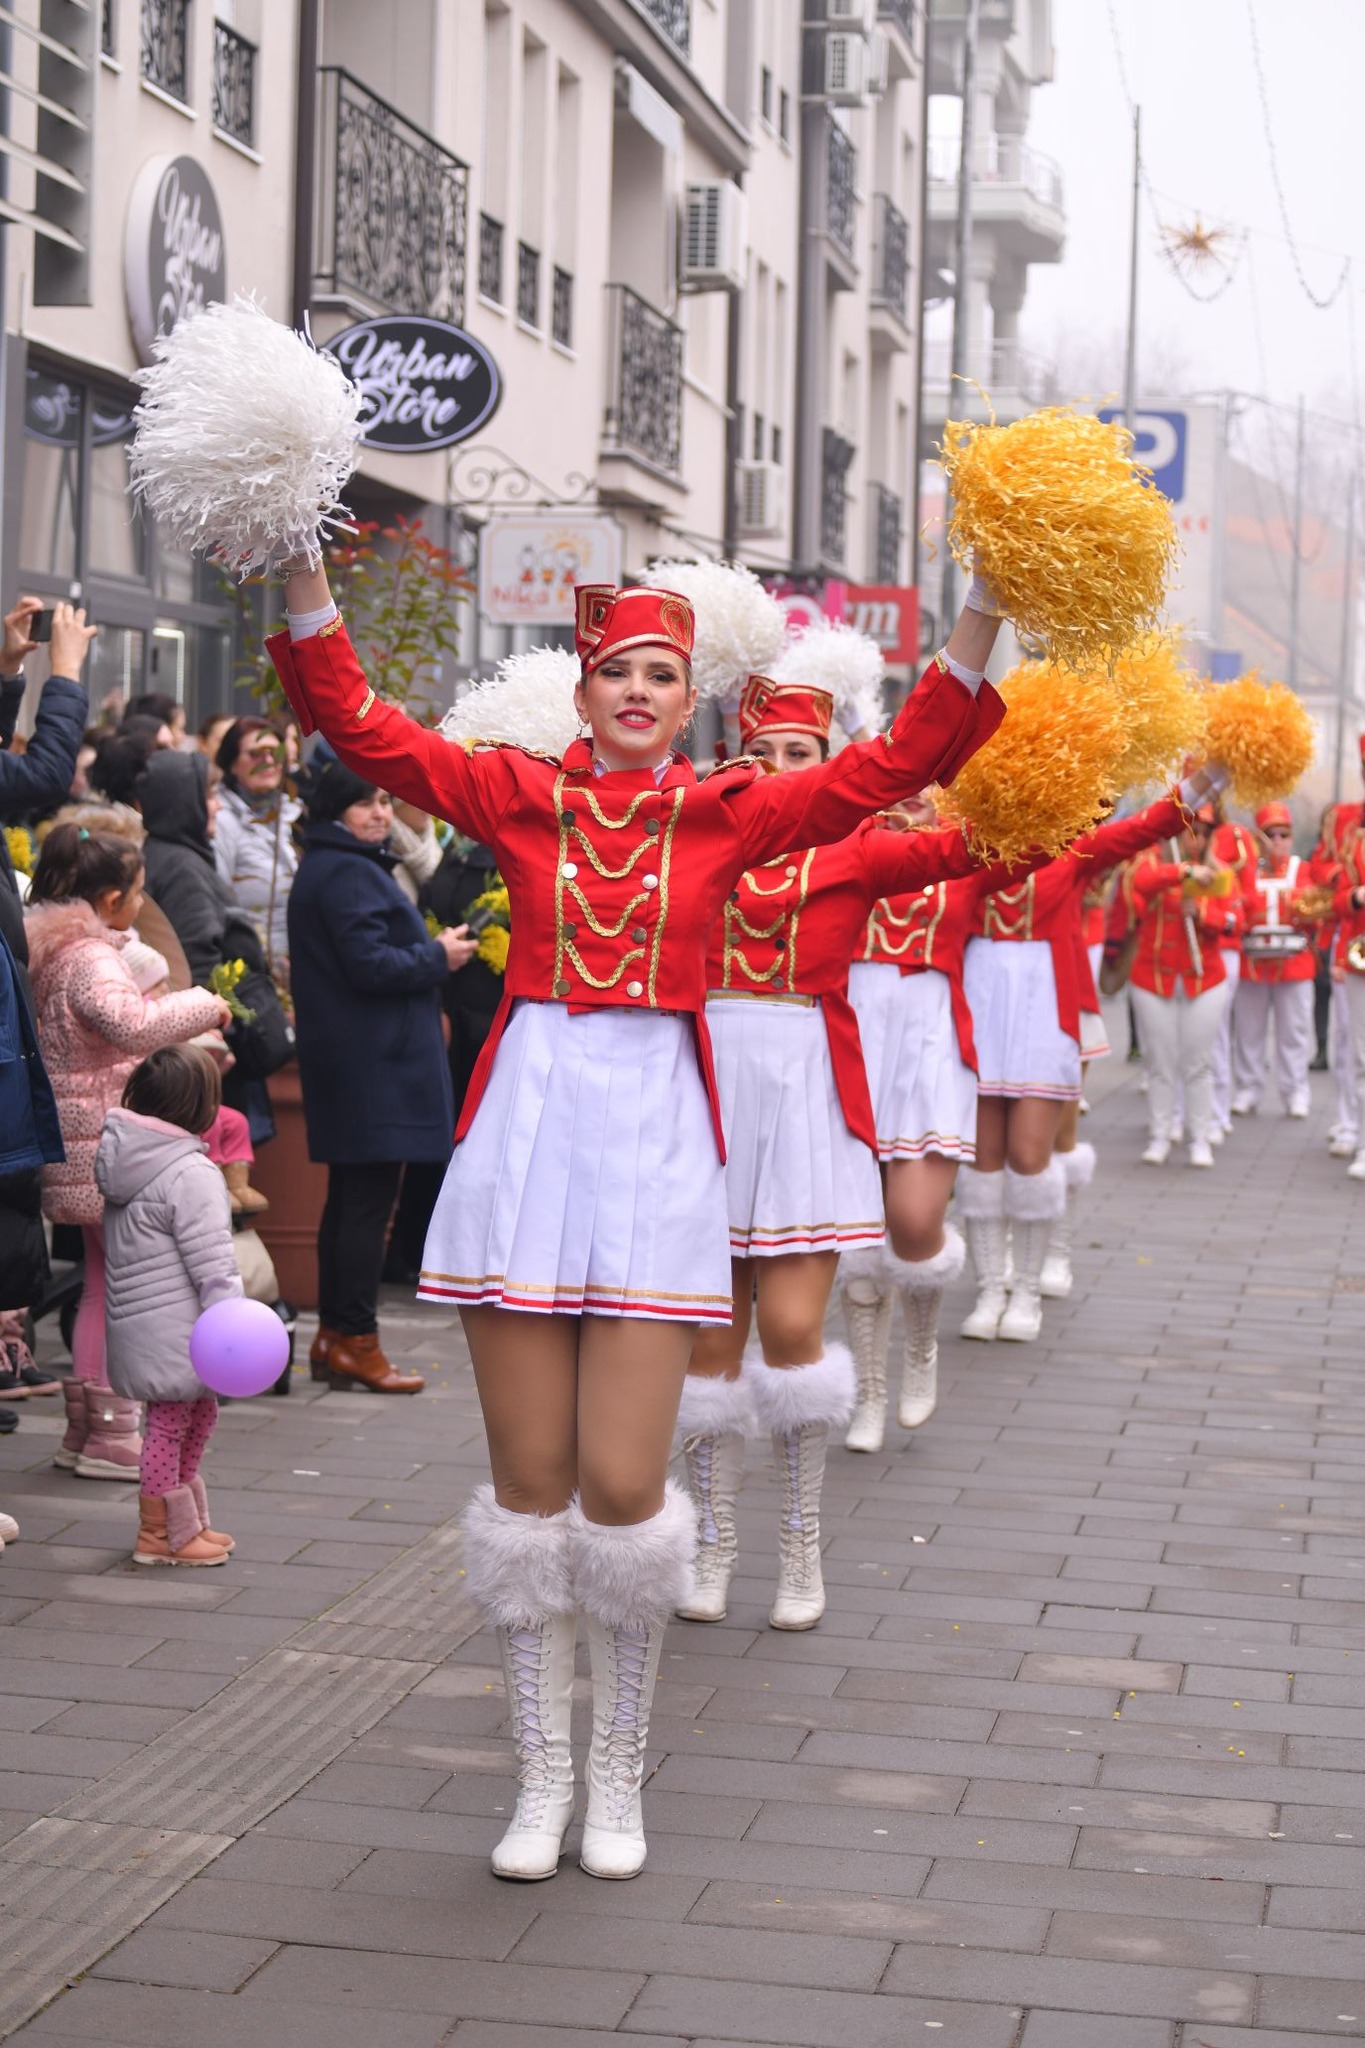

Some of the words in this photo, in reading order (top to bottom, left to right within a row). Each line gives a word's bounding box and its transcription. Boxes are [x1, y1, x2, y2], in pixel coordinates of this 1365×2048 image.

[158, 166, 221, 274] Urban
[338, 328, 478, 383] Urban
[358, 374, 461, 438] Store
